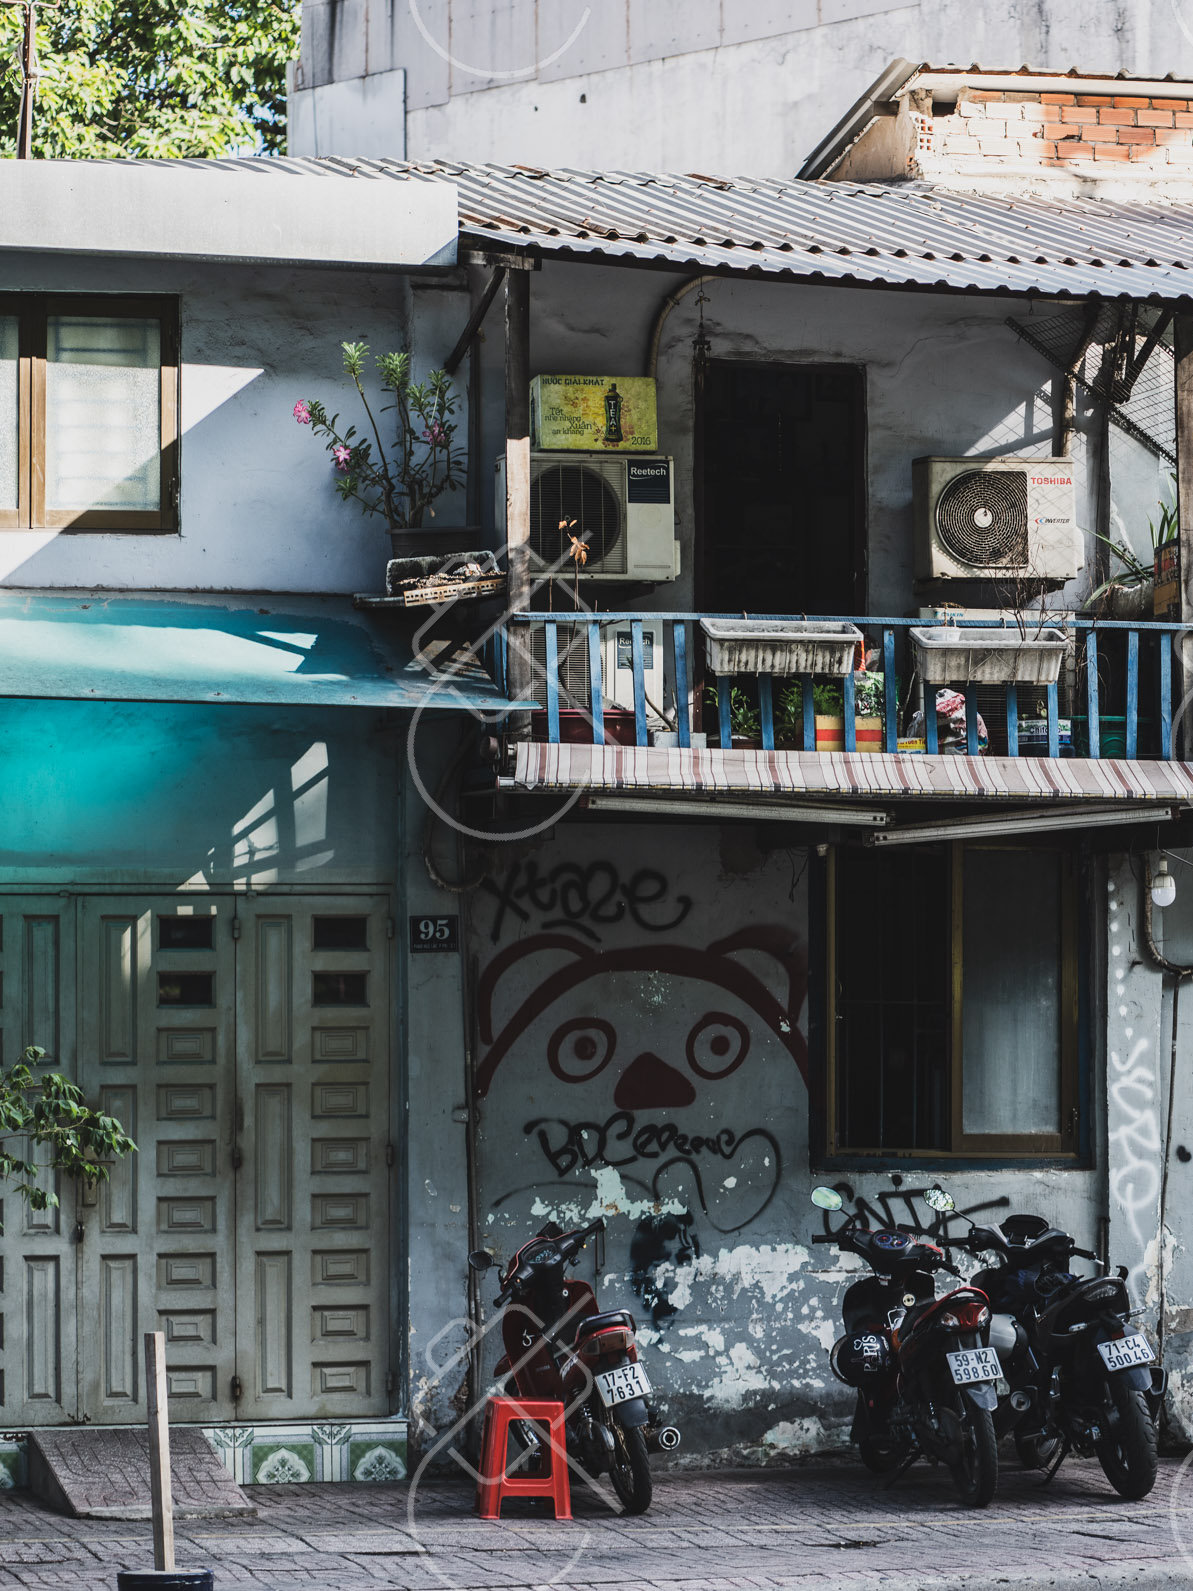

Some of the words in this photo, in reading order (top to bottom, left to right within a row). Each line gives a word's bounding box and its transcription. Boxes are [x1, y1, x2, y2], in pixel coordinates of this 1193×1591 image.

[630, 436, 652, 446] 2016
[629, 466, 667, 476] Reetech
[1030, 477, 1073, 486] TOSHIBA
[418, 919, 451, 940] 95
[1104, 1338, 1142, 1356] 71-C4
[954, 1351, 991, 1368] 59-N2
[1107, 1347, 1150, 1368] 500.46
[602, 1366, 640, 1388] 17-F2
[953, 1364, 999, 1382] 598.60
